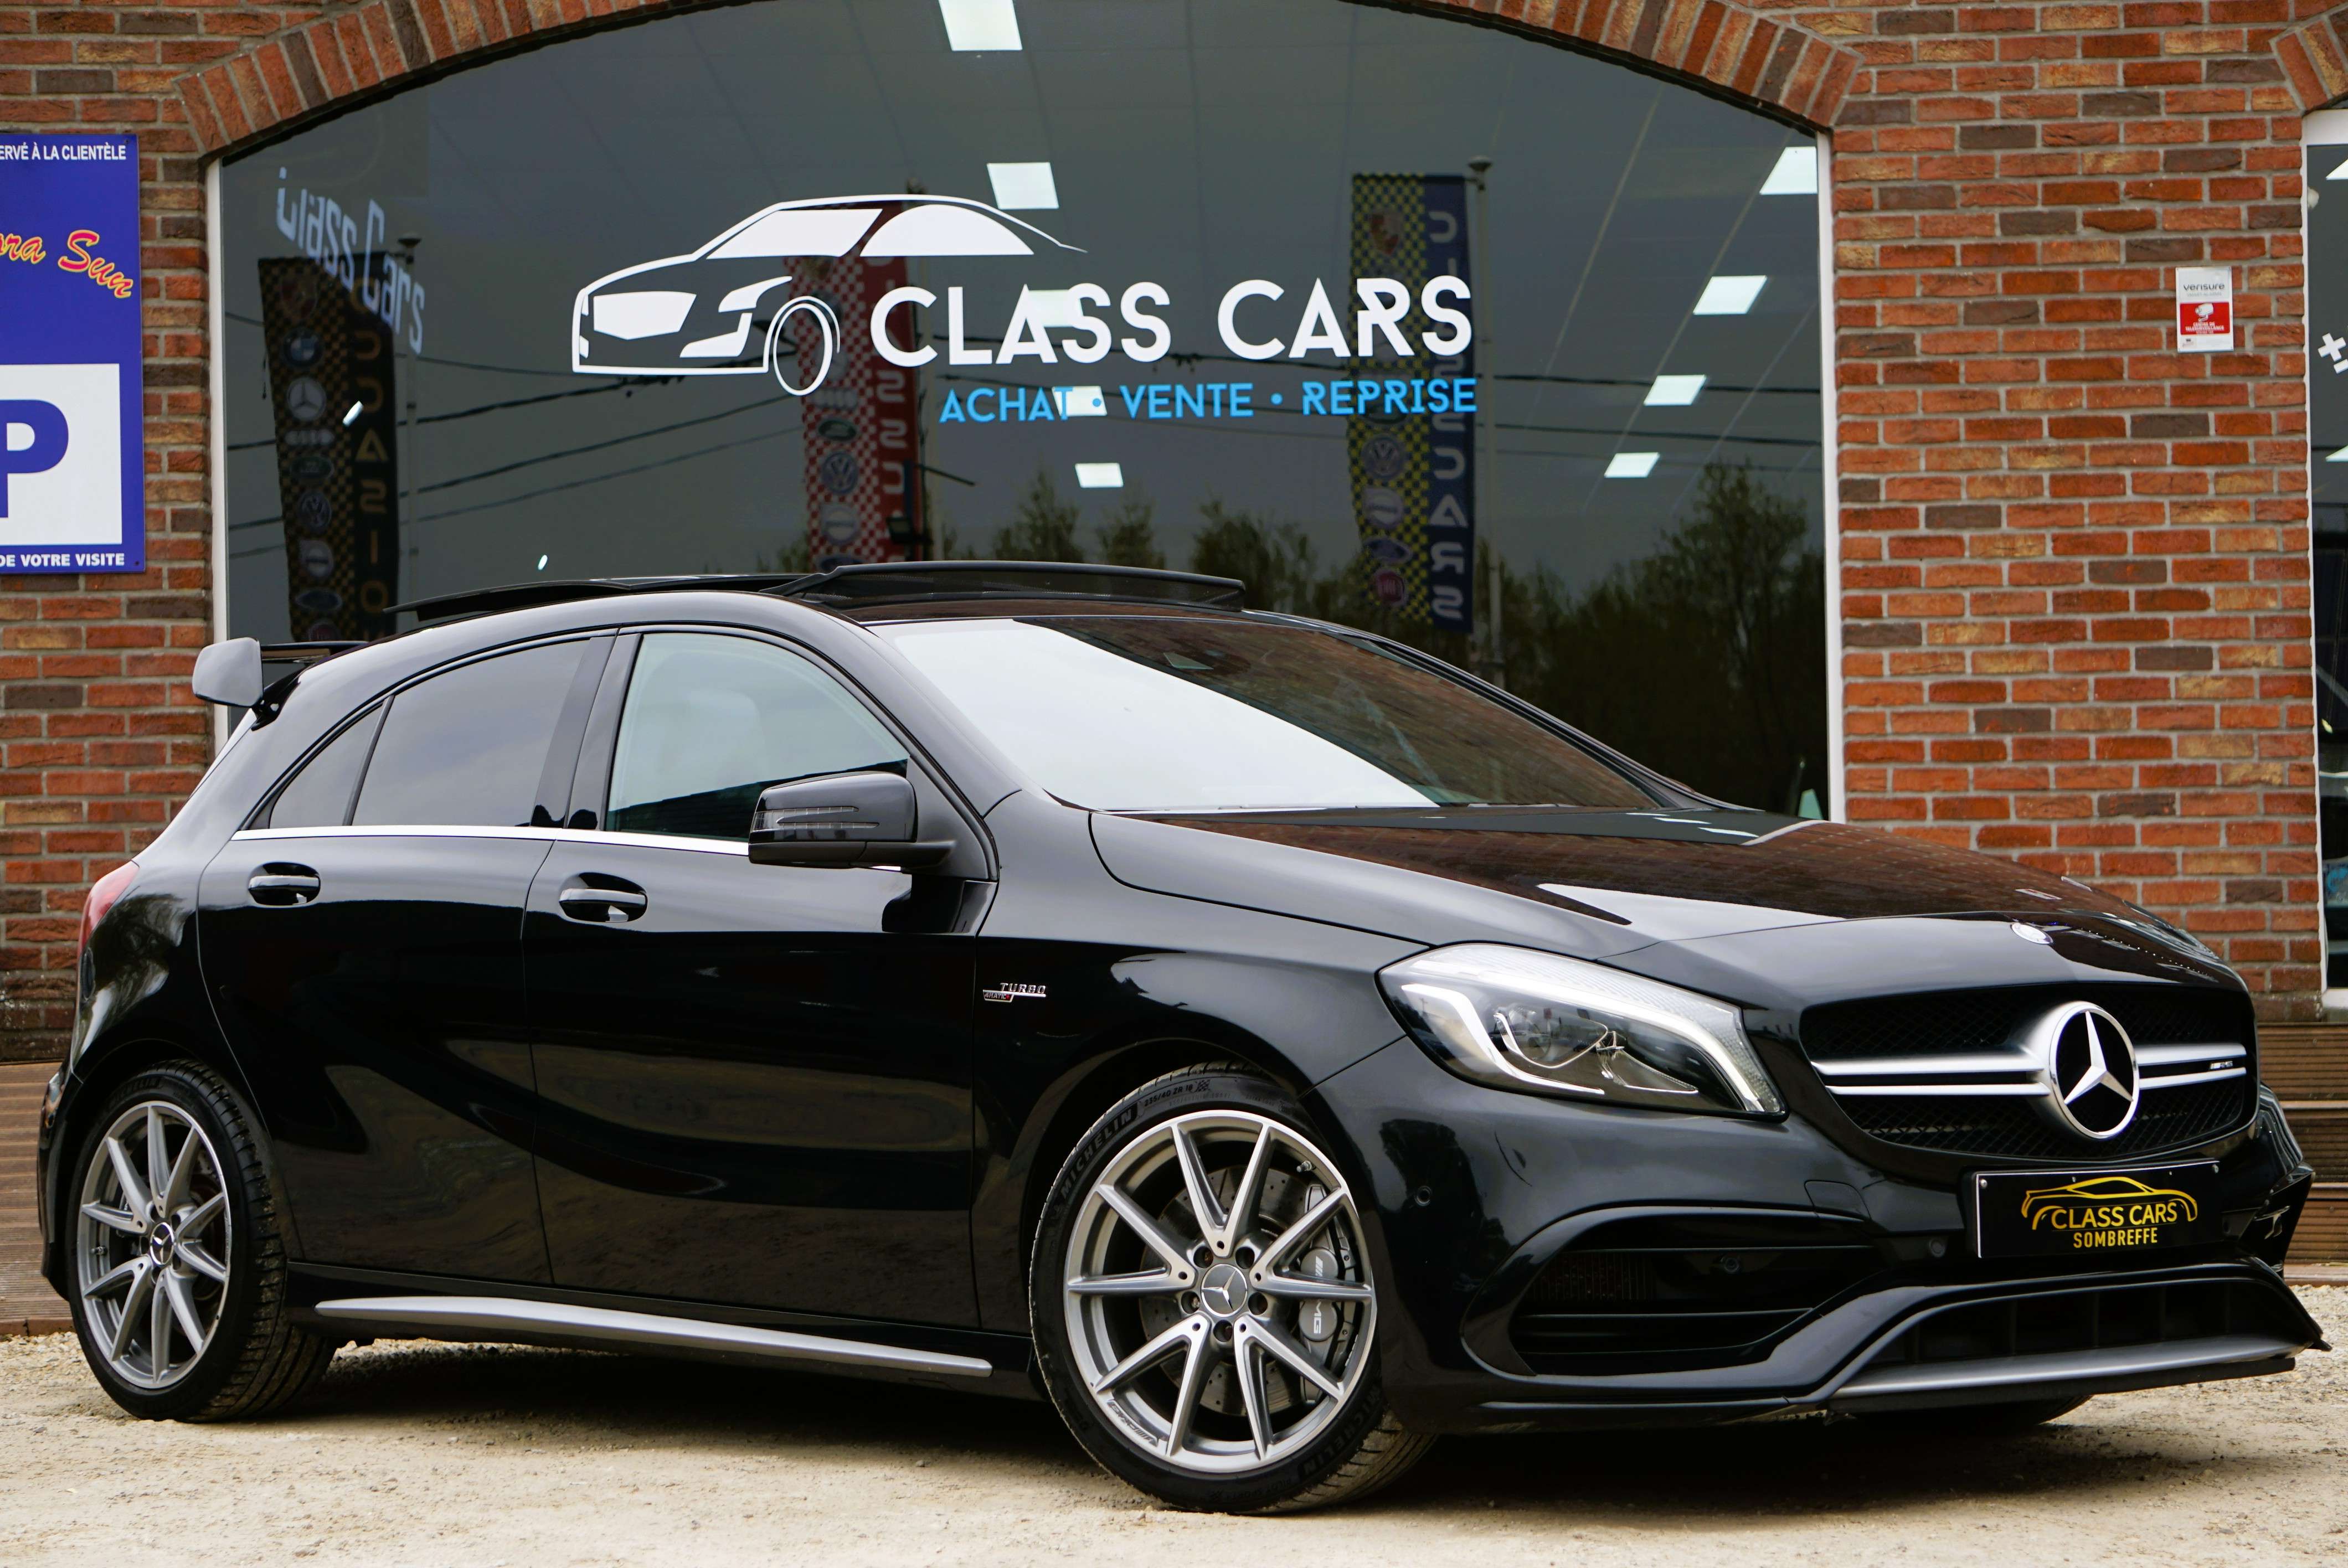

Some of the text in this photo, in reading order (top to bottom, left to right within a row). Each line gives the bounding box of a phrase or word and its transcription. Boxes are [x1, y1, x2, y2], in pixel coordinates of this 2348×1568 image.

[32, 142, 40, 160] À
[43, 145, 59, 160] LA
[61, 142, 126, 160] CLIENTÈLE
[58, 229, 133, 298] Sun
[363, 199, 425, 355] Cars
[2183, 283, 2225, 291] verisure
[871, 275, 1471, 367] CLASS CARS
[939, 378, 1477, 422] ACHAT VENTE REPRISE
[0, 400, 69, 518] P
[20, 554, 70, 567] VOTRE
[75, 553, 125, 566] VISITE
[1000, 982, 1046, 994] TURBO
[1060, 1108, 1132, 1199] MICHELIN
[2051, 1201, 2177, 1229] CLASS CARS
[2073, 1227, 2158, 1248] SOMBREFFE
